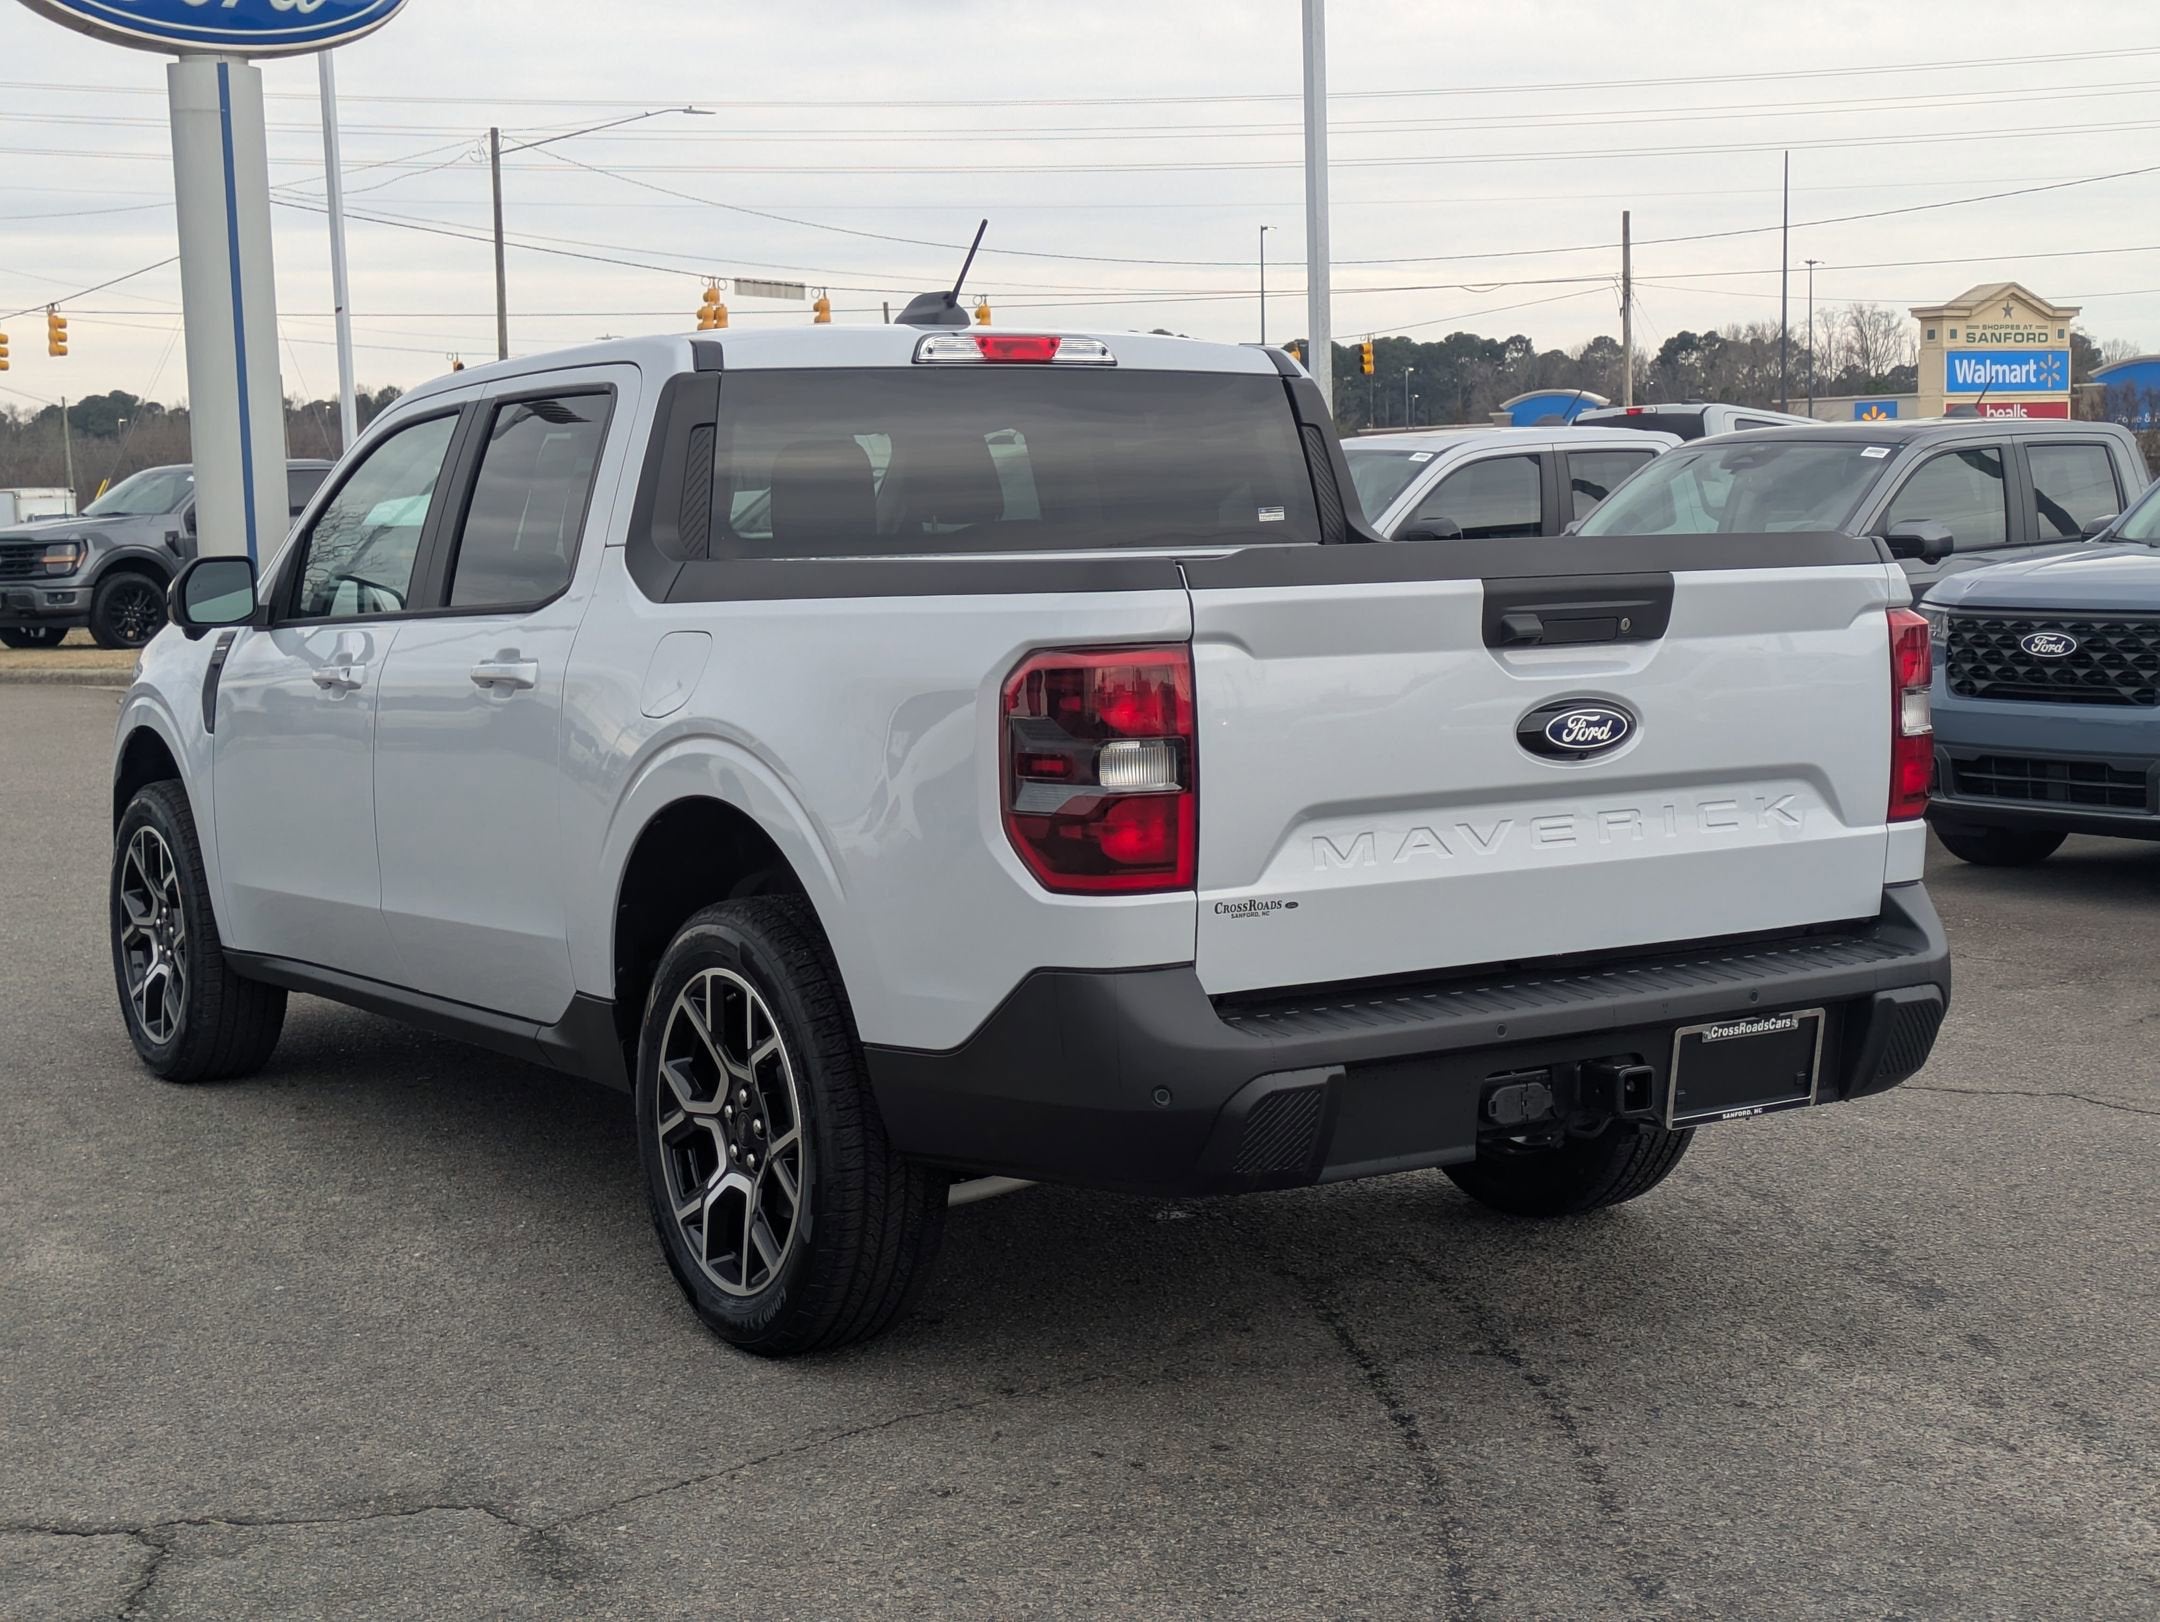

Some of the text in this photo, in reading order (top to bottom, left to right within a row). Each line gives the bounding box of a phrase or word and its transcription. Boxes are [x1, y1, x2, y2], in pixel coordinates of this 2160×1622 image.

[1966, 332, 2049, 343] SANFORD
[1954, 359, 2037, 384] Walmart
[2031, 635, 2066, 653] Ford
[1562, 714, 1613, 743] Ford
[1312, 793, 1801, 872] MAVERICK
[1711, 1017, 1791, 1039] CrossRoadsCars
[1722, 1107, 1763, 1119] SANFORD, NC
